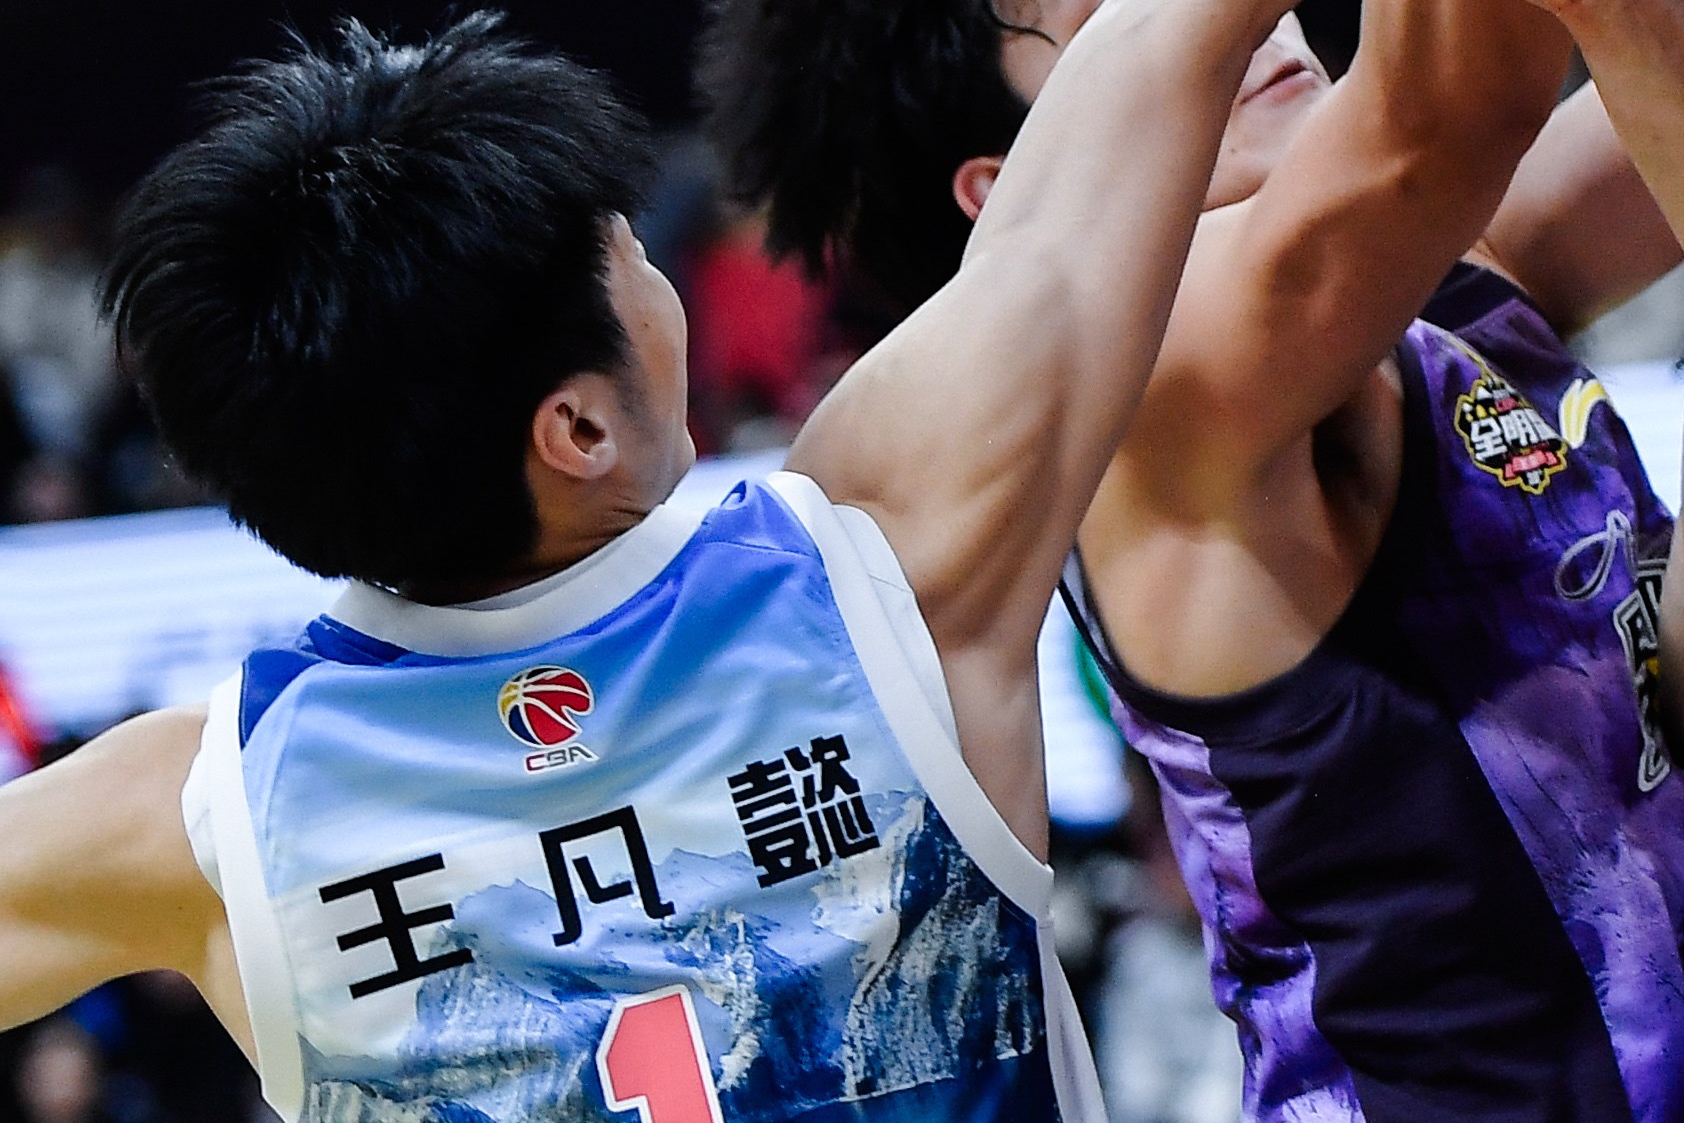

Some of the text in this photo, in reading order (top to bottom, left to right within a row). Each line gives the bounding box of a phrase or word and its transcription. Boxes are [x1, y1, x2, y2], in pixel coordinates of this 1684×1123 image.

[524, 745, 597, 772] CBA
[319, 734, 881, 999] 王凡懿
